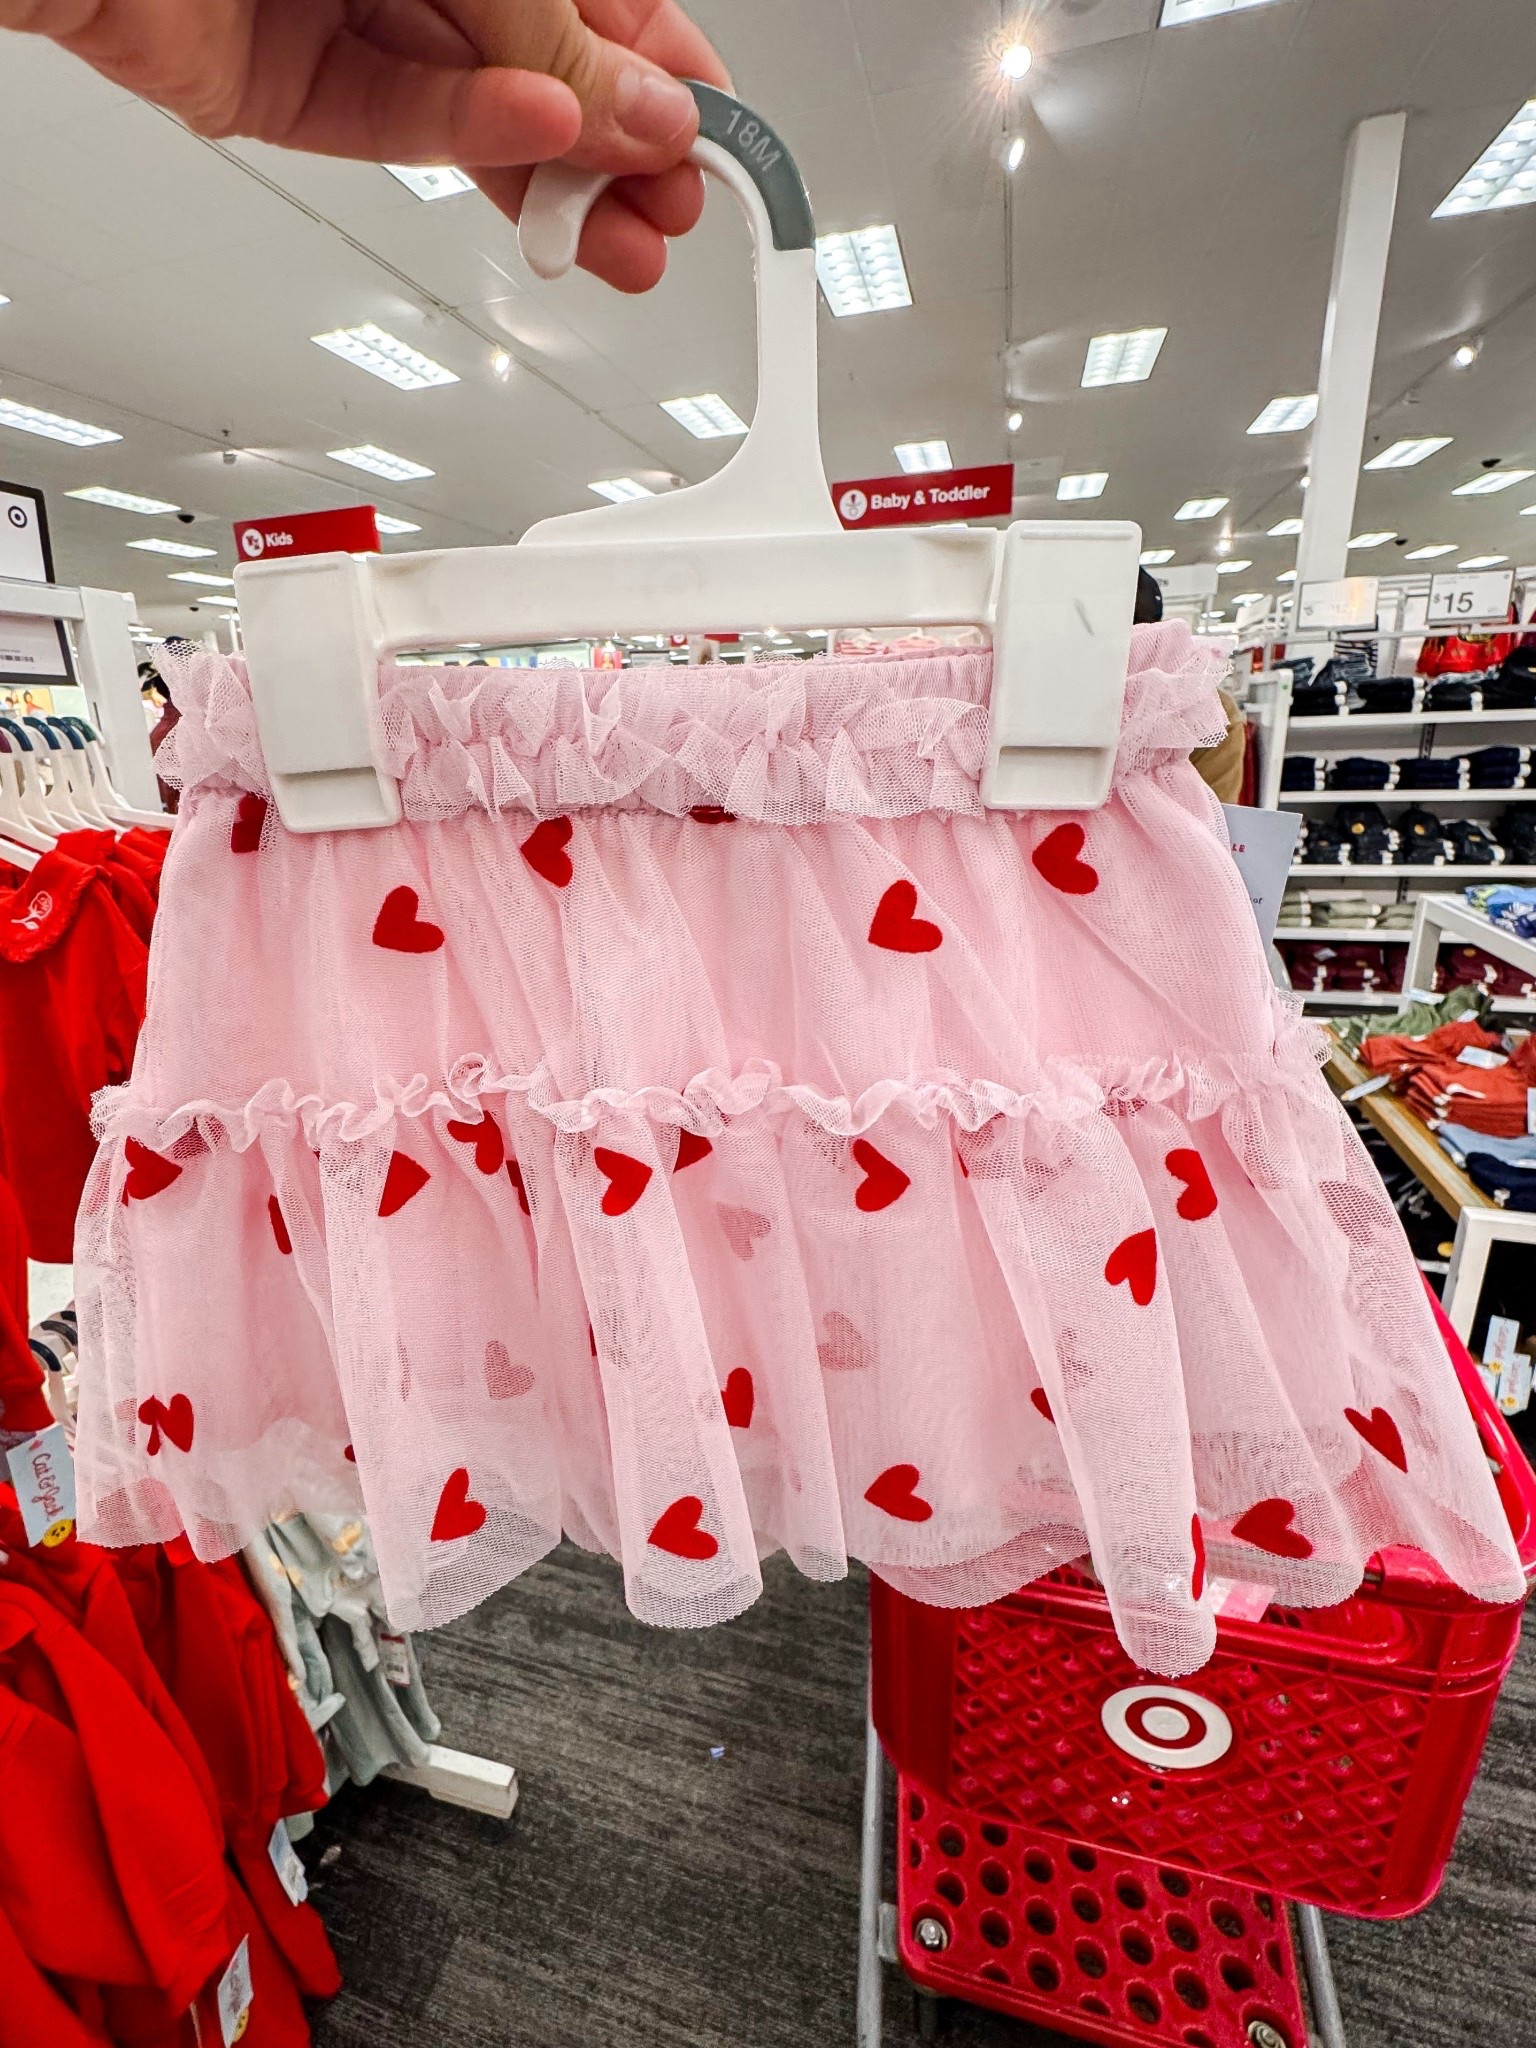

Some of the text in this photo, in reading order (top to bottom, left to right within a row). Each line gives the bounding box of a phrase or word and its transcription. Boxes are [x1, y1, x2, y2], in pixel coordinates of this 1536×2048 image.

[726, 109, 781, 171] 18M
[870, 485, 990, 510] Baby & Toddler
[264, 532, 294, 547] Kids
